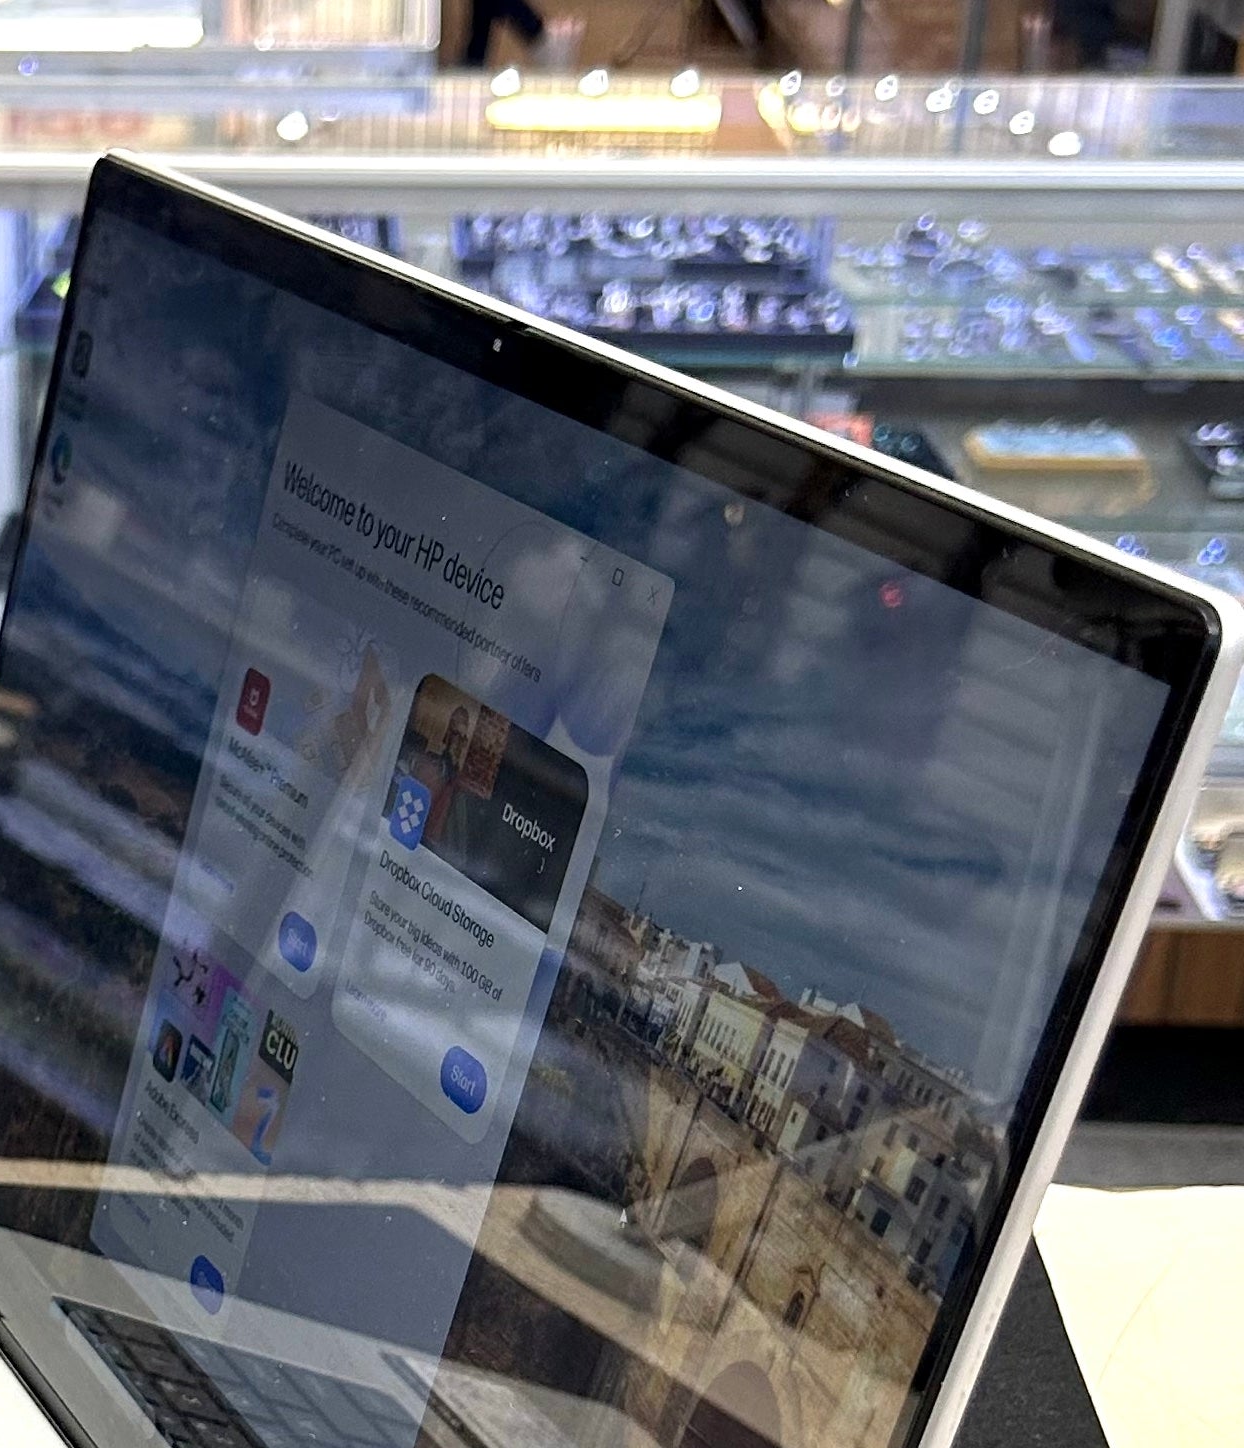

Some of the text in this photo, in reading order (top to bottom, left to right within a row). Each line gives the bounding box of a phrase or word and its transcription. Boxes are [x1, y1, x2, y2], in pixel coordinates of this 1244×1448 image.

[283, 460, 507, 610] Welcome to your HP device
[410, 594, 474, 642] recommended
[473, 630, 511, 666] partner
[511, 651, 542, 683] offers
[502, 803, 555, 855] Dropbox
[380, 851, 494, 952] Dropbox Cloud Storage
[363, 911, 395, 948] Dropbox
[395, 936, 412, 959] free
[423, 957, 436, 977] 90
[369, 889, 503, 1003] Store your big ideas with 100 GB of
[265, 1029, 295, 1070] CLU
[450, 1062, 476, 1096] Start
